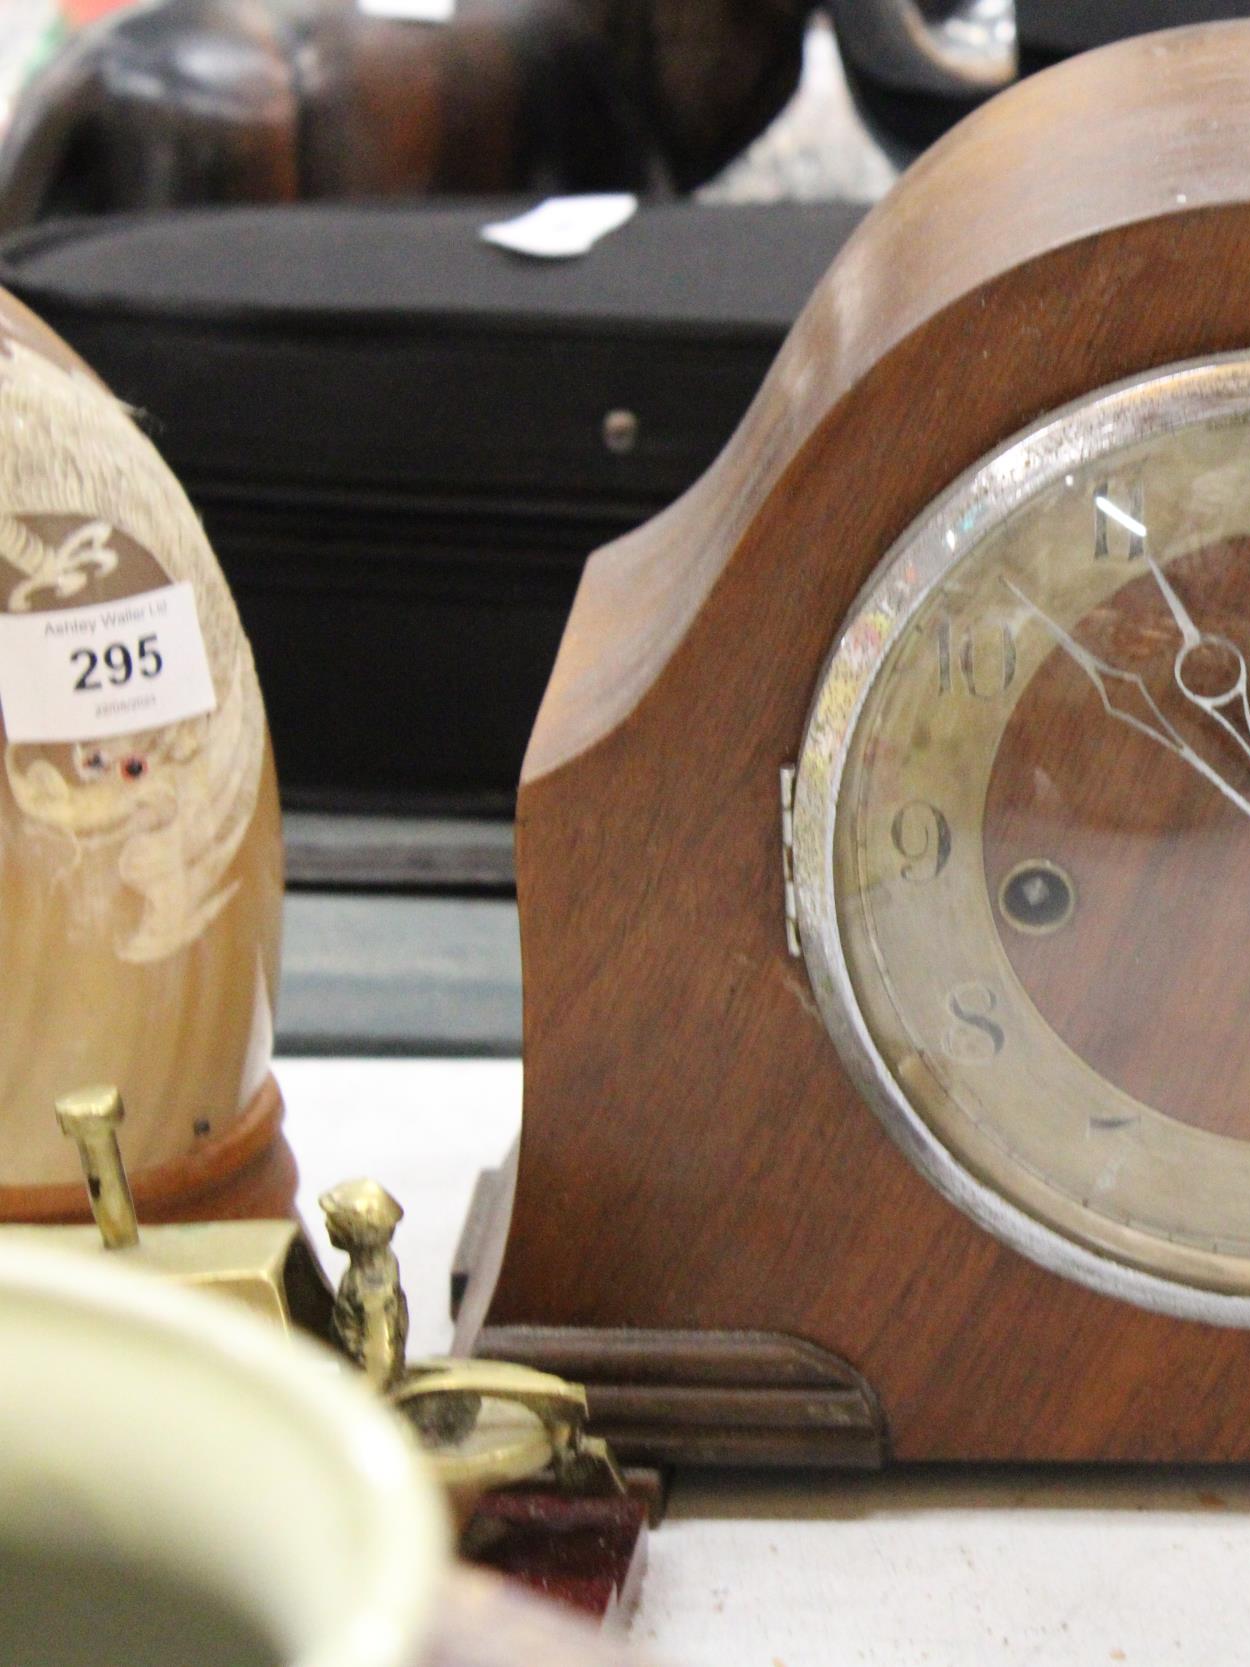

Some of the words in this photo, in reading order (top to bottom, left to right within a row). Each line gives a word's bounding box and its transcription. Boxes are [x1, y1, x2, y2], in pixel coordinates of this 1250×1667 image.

[44, 617, 97, 637] Ashley
[70, 633, 163, 691] 295
[936, 618, 1017, 700] 10
[891, 803, 952, 883] 9
[940, 980, 1005, 1065] 8
